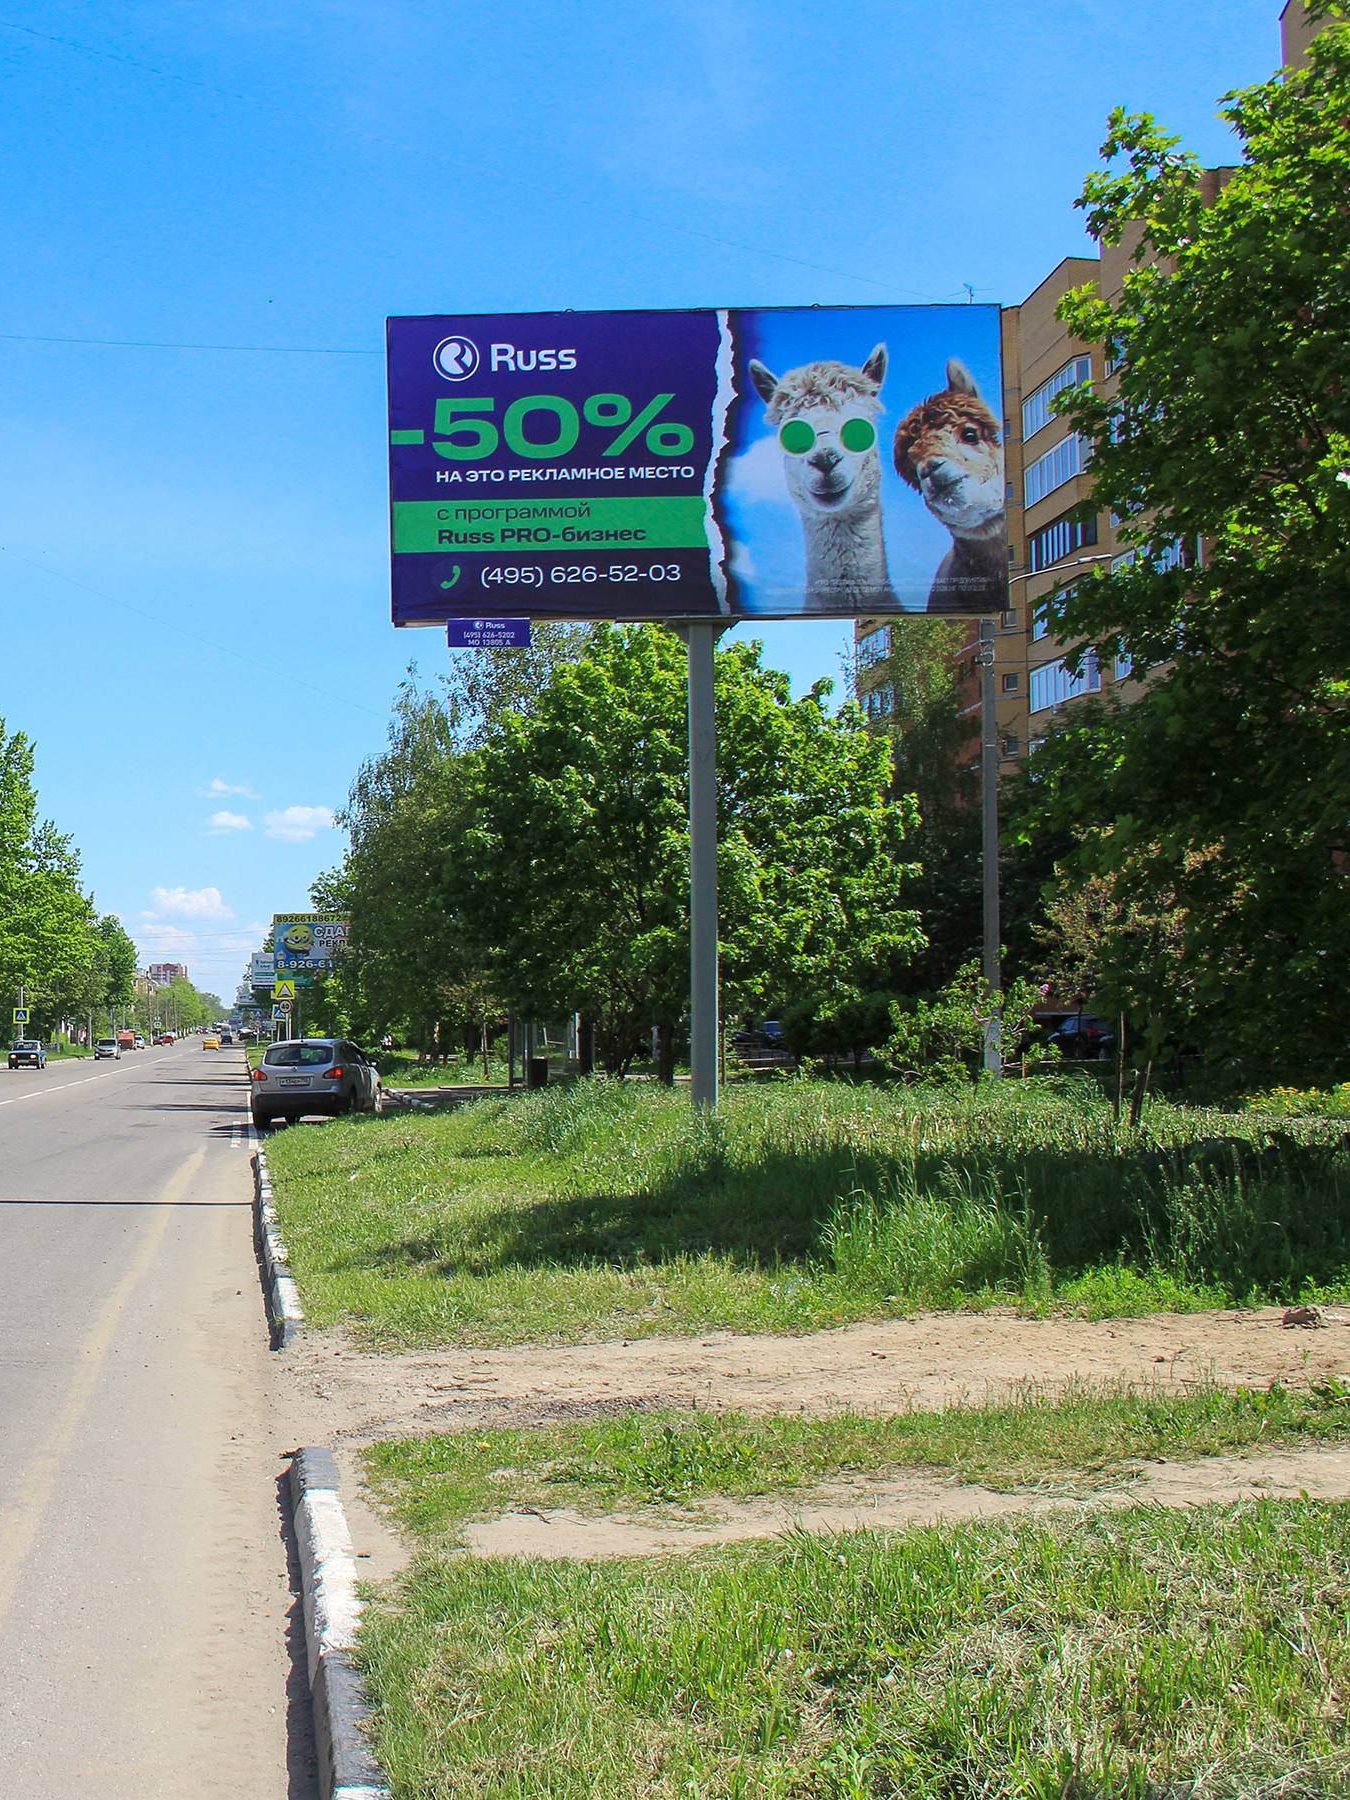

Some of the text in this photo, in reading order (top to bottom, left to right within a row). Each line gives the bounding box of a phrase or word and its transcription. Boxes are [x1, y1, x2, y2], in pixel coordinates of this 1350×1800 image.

[489, 343, 577, 372] Russ
[390, 393, 695, 461] -50%
[436, 466, 695, 483] НА ЭТО РЕКЛАМНОЕ МЕСТО
[437, 502, 591, 523] с программой
[437, 526, 647, 545] Russ PRO-бизнес
[481, 564, 681, 588] (495) 626-52-03
